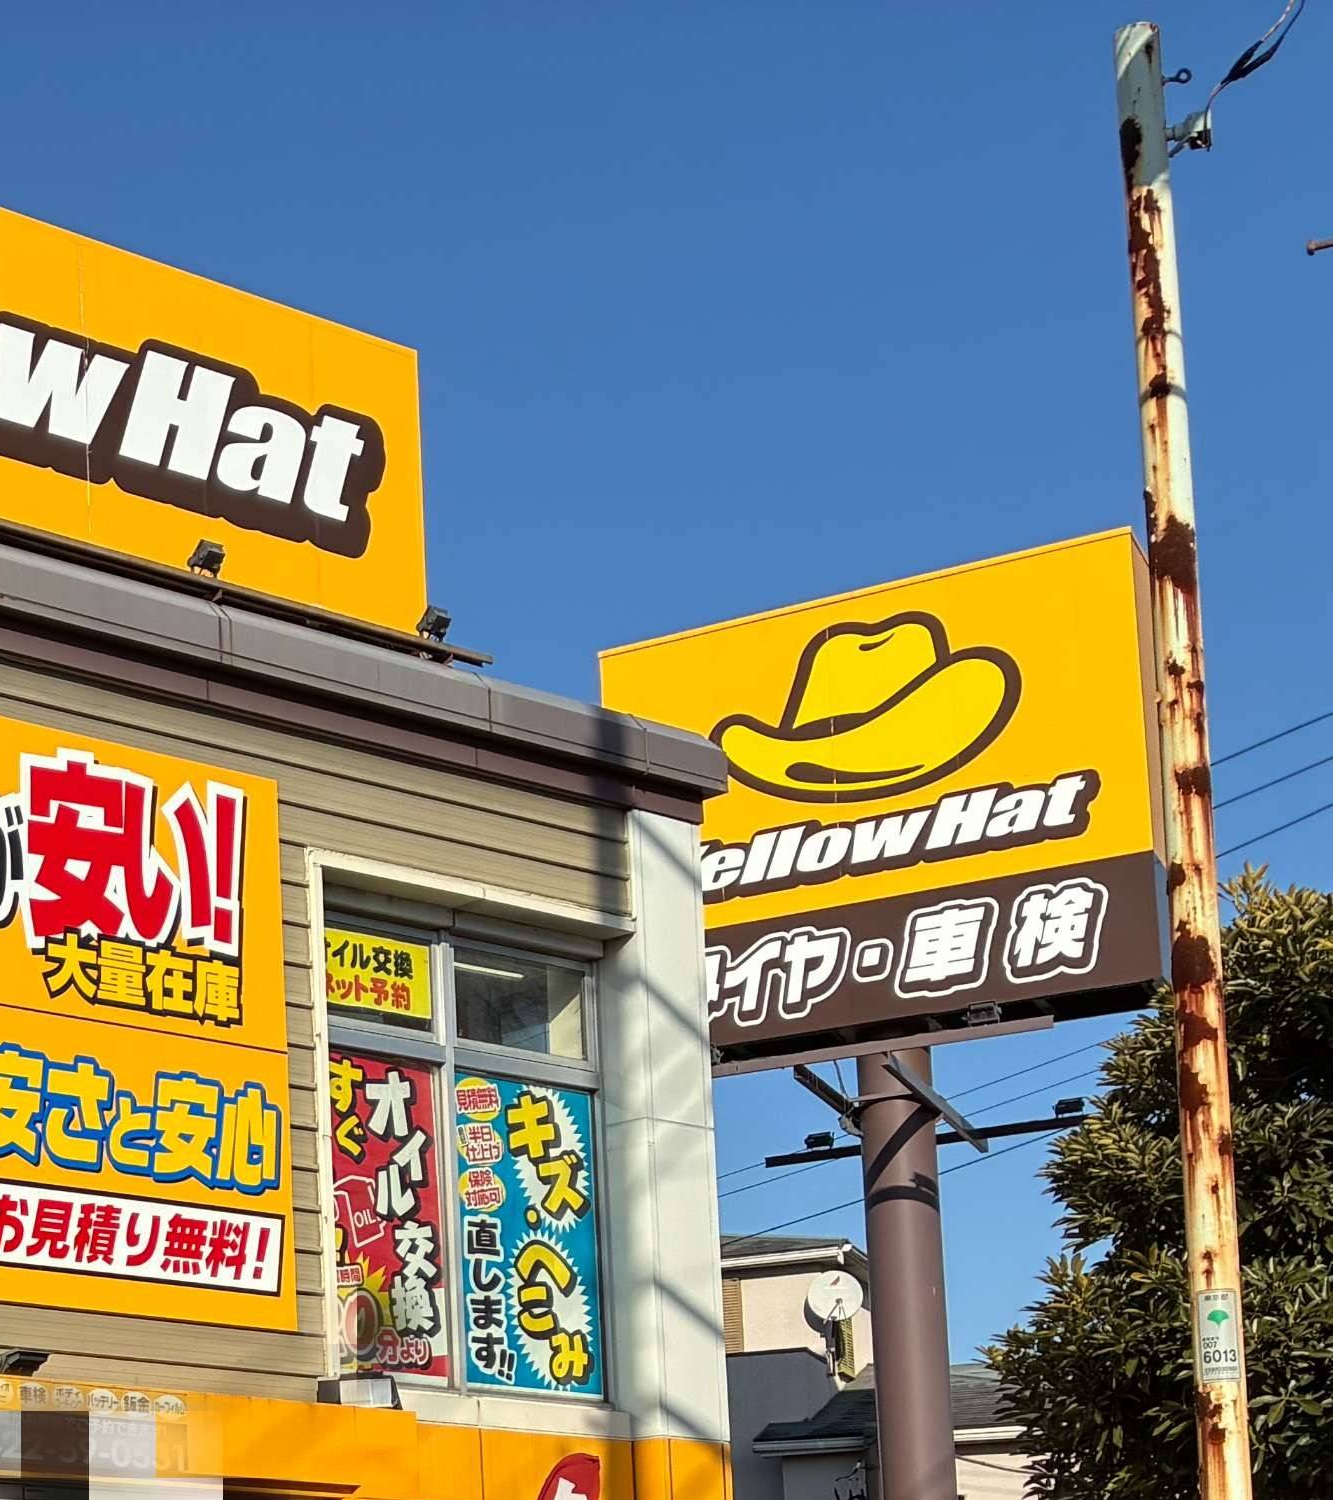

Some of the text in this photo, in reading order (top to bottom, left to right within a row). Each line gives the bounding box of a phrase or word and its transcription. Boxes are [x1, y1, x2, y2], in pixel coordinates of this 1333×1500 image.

[41, 932, 242, 1030] 大量在庫
[365, 1070, 439, 1332] オイル交換
[1203, 1348, 1237, 1364] 6013
